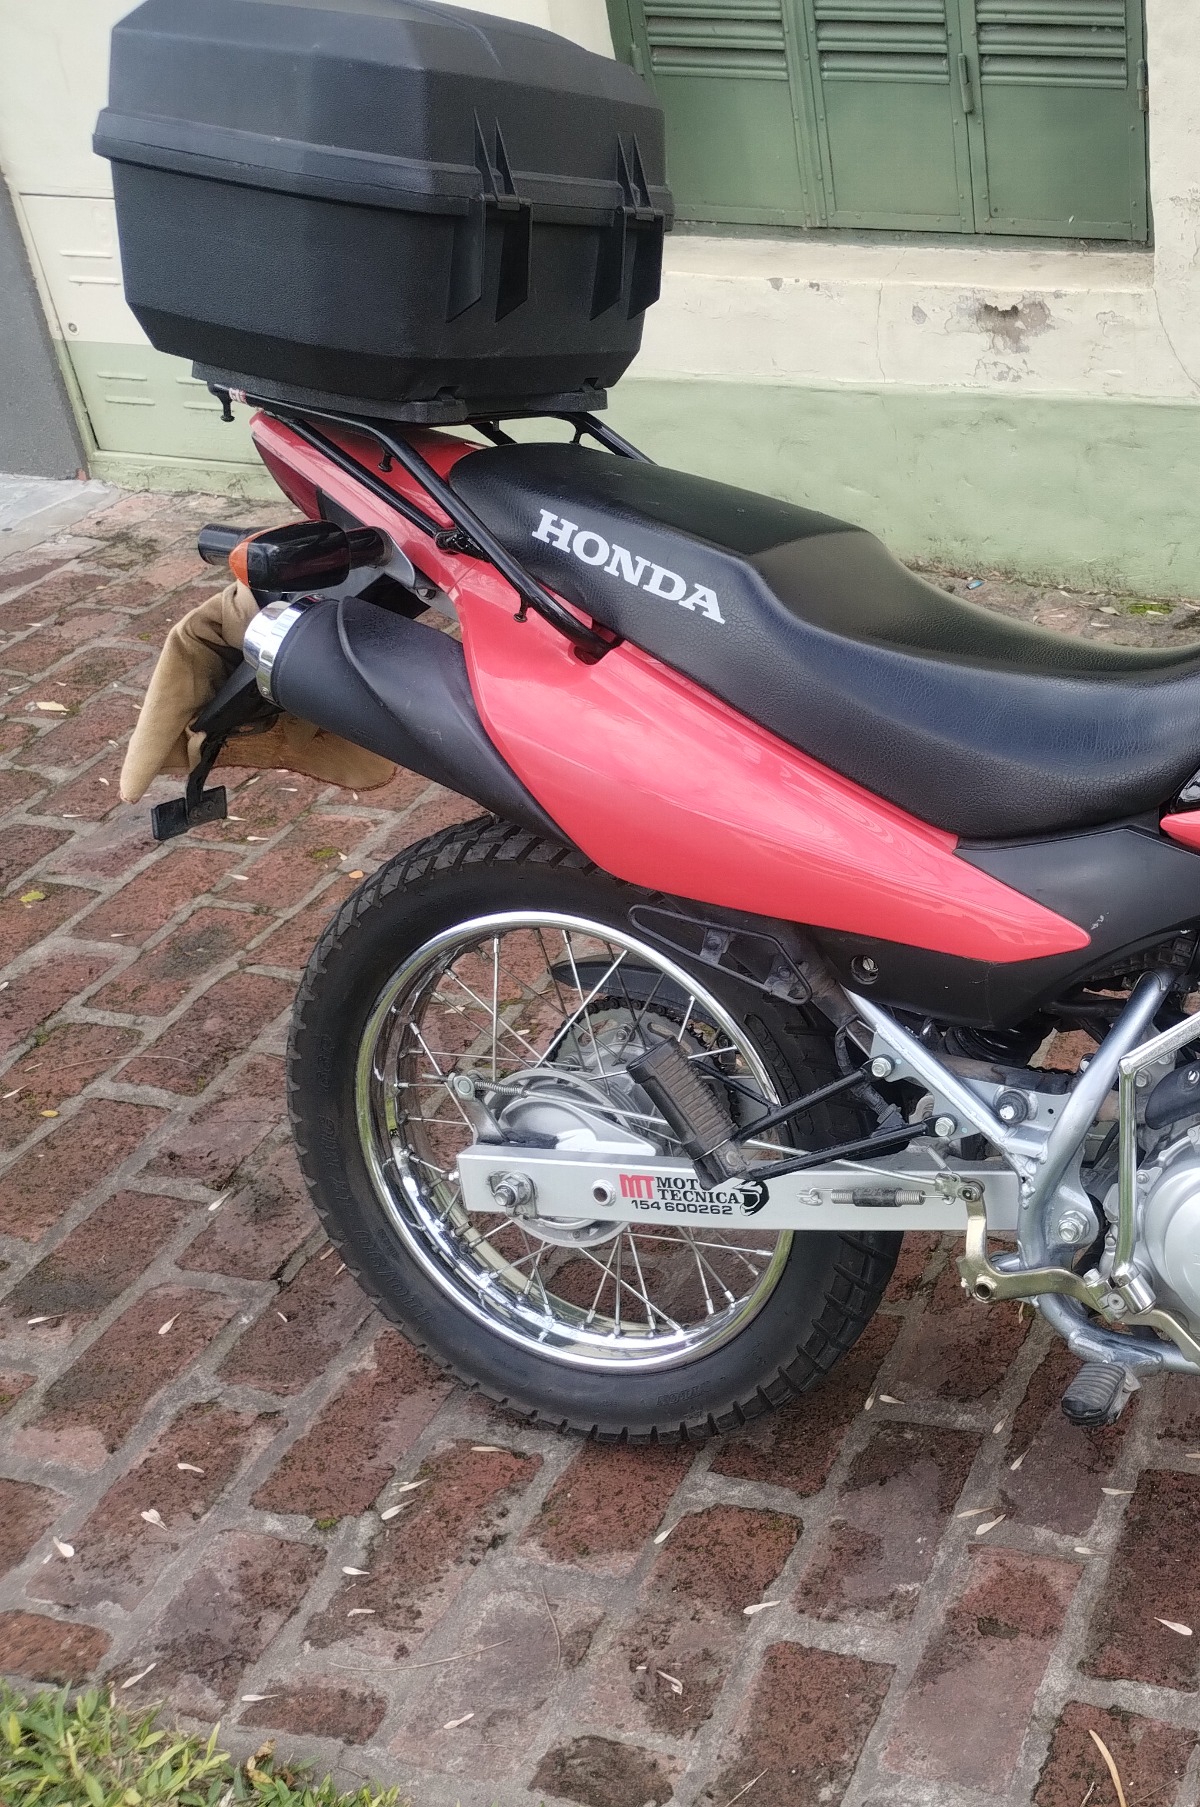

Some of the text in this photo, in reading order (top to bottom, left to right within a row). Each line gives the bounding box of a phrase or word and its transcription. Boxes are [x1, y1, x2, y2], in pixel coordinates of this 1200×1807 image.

[531, 508, 726, 625] HONDA
[619, 1173, 655, 1200] MT
[655, 1176, 703, 1190] MOT
[657, 1189, 741, 1204] TECNICA
[632, 1200, 733, 1216] 154 600262
